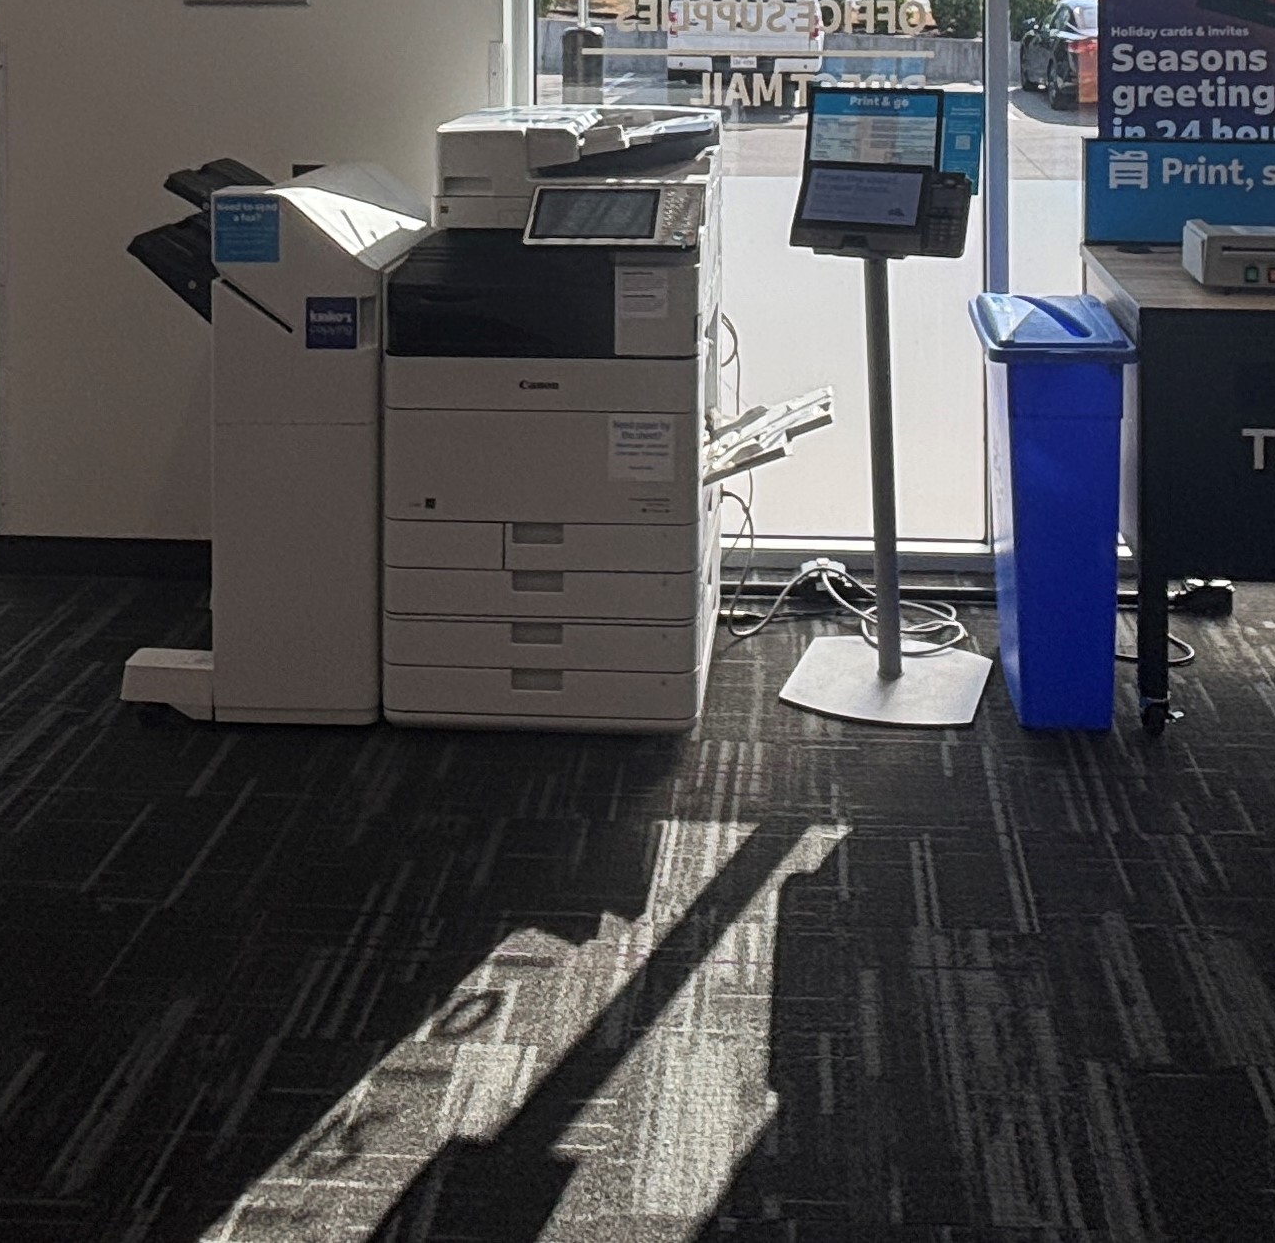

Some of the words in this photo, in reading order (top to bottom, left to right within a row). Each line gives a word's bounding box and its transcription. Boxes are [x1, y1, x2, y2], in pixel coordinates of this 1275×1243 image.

[1110, 26, 1157, 40] Holiday
[1159, 26, 1194, 38] cards
[1195, 27, 1205, 38] &
[1207, 25, 1250, 38] invites
[1111, 43, 1268, 72] Seasons
[849, 95, 879, 107] Print
[881, 97, 891, 107] &
[893, 97, 910, 110] go
[1112, 117, 1146, 139] in
[1155, 119, 1201, 139] 24
[1161, 155, 1255, 193] Print,
[518, 379, 559, 390] Canon
